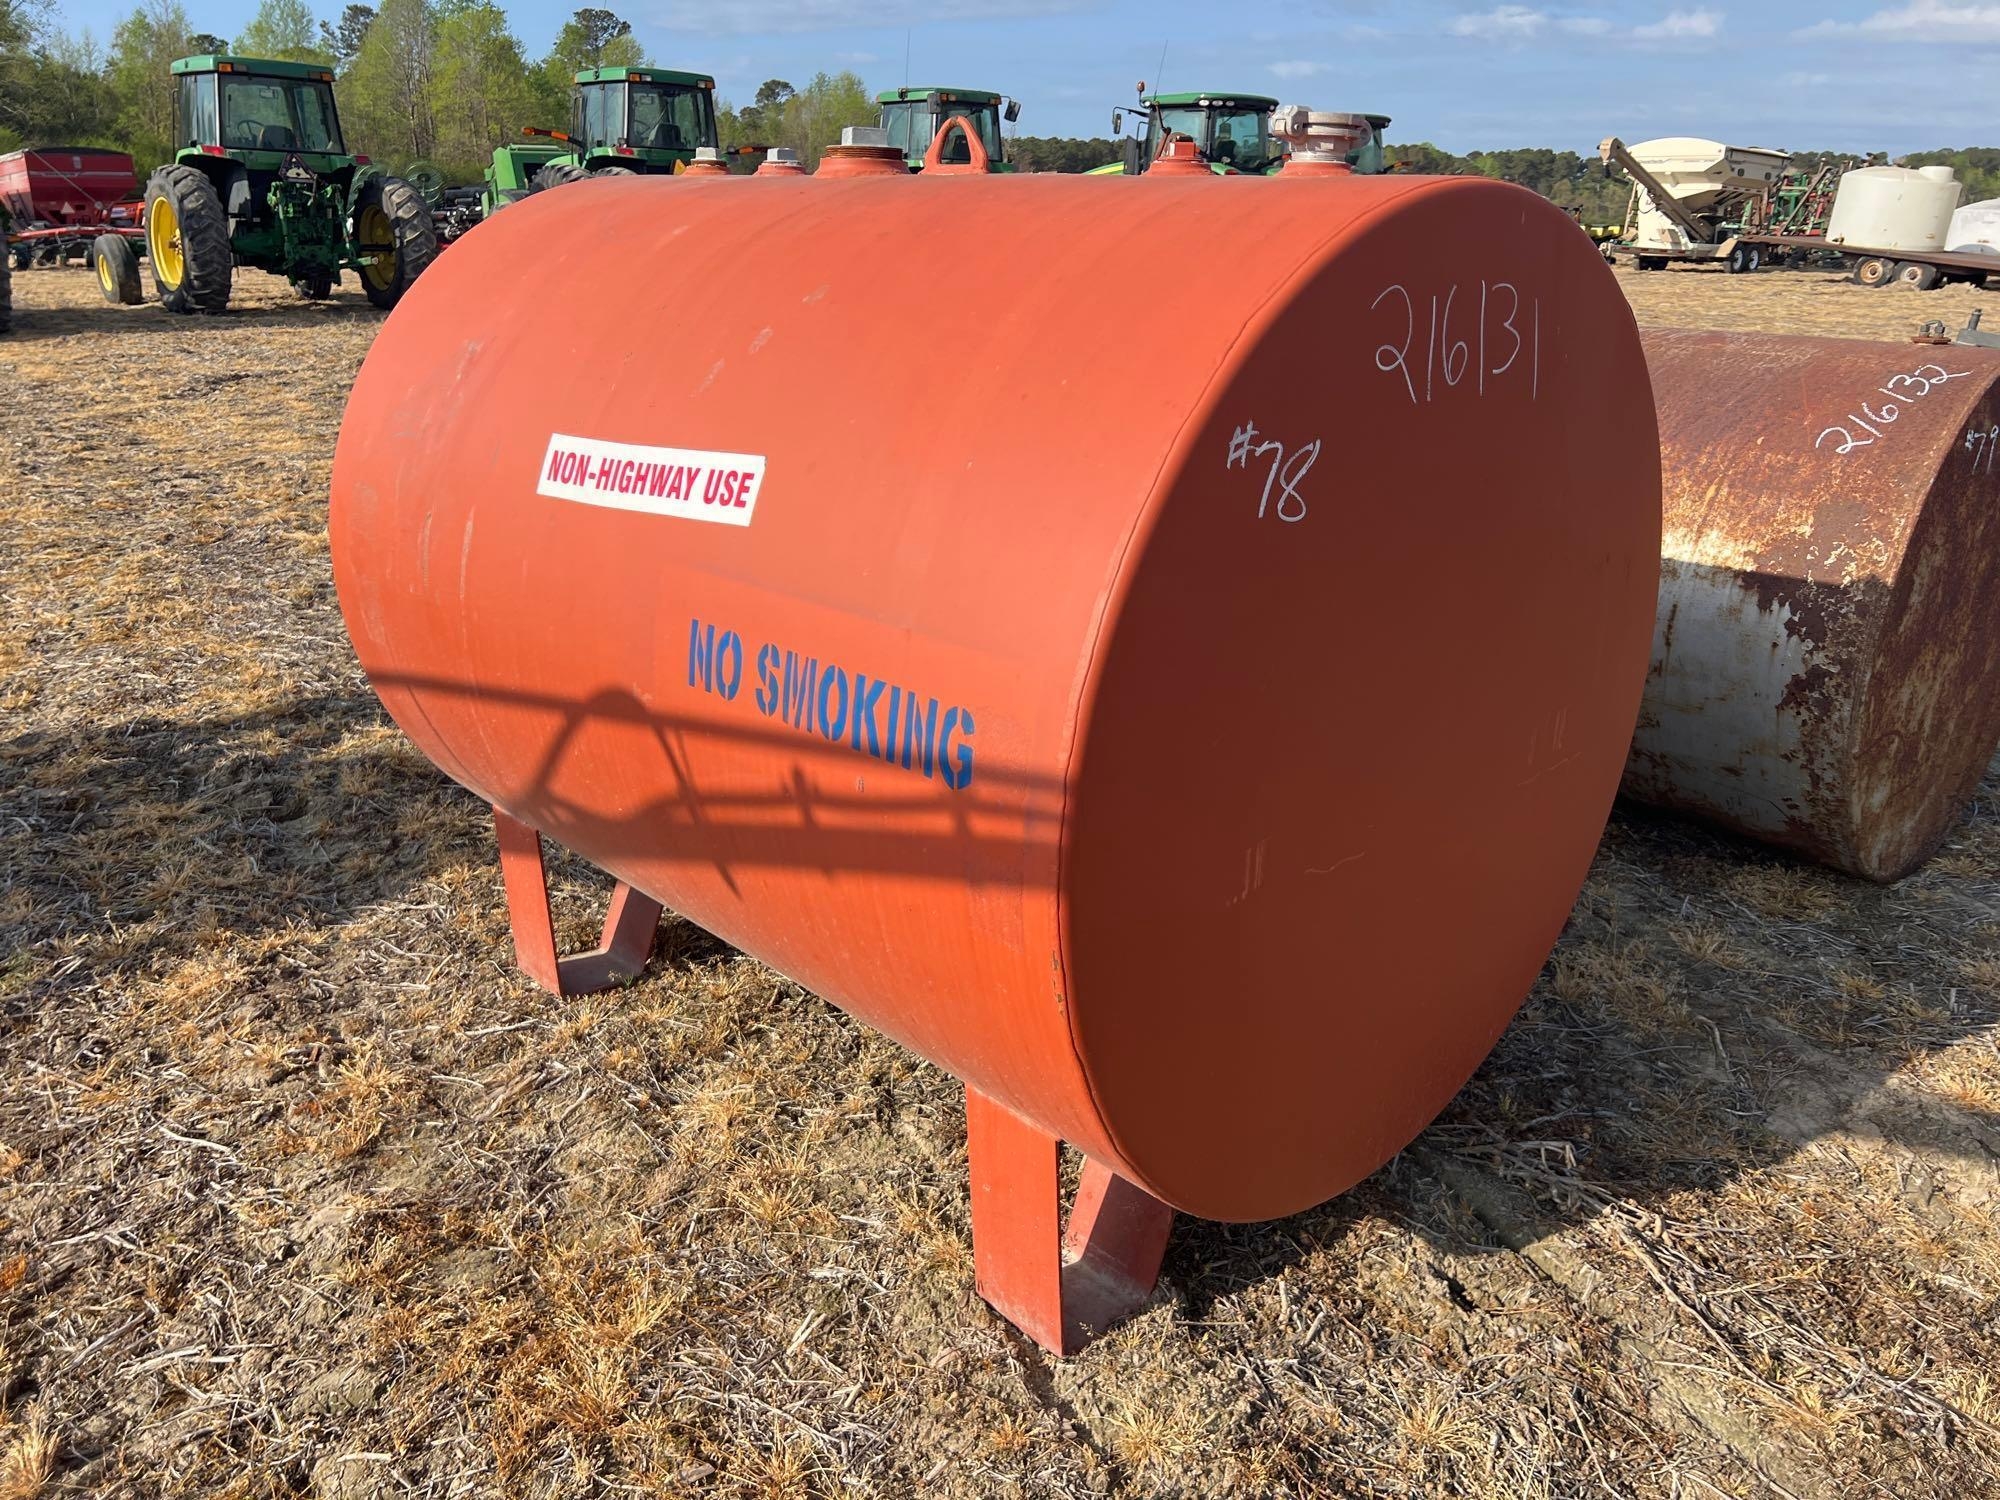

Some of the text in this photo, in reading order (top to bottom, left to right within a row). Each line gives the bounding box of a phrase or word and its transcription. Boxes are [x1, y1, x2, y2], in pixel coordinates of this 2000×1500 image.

[1370, 279, 1538, 403] 216131
[1815, 364, 1973, 454] 216132
[547, 449, 755, 508] NON-HIGHWAY USE
[1226, 420, 1321, 522] #78
[688, 619, 976, 791] NO SMOKING
